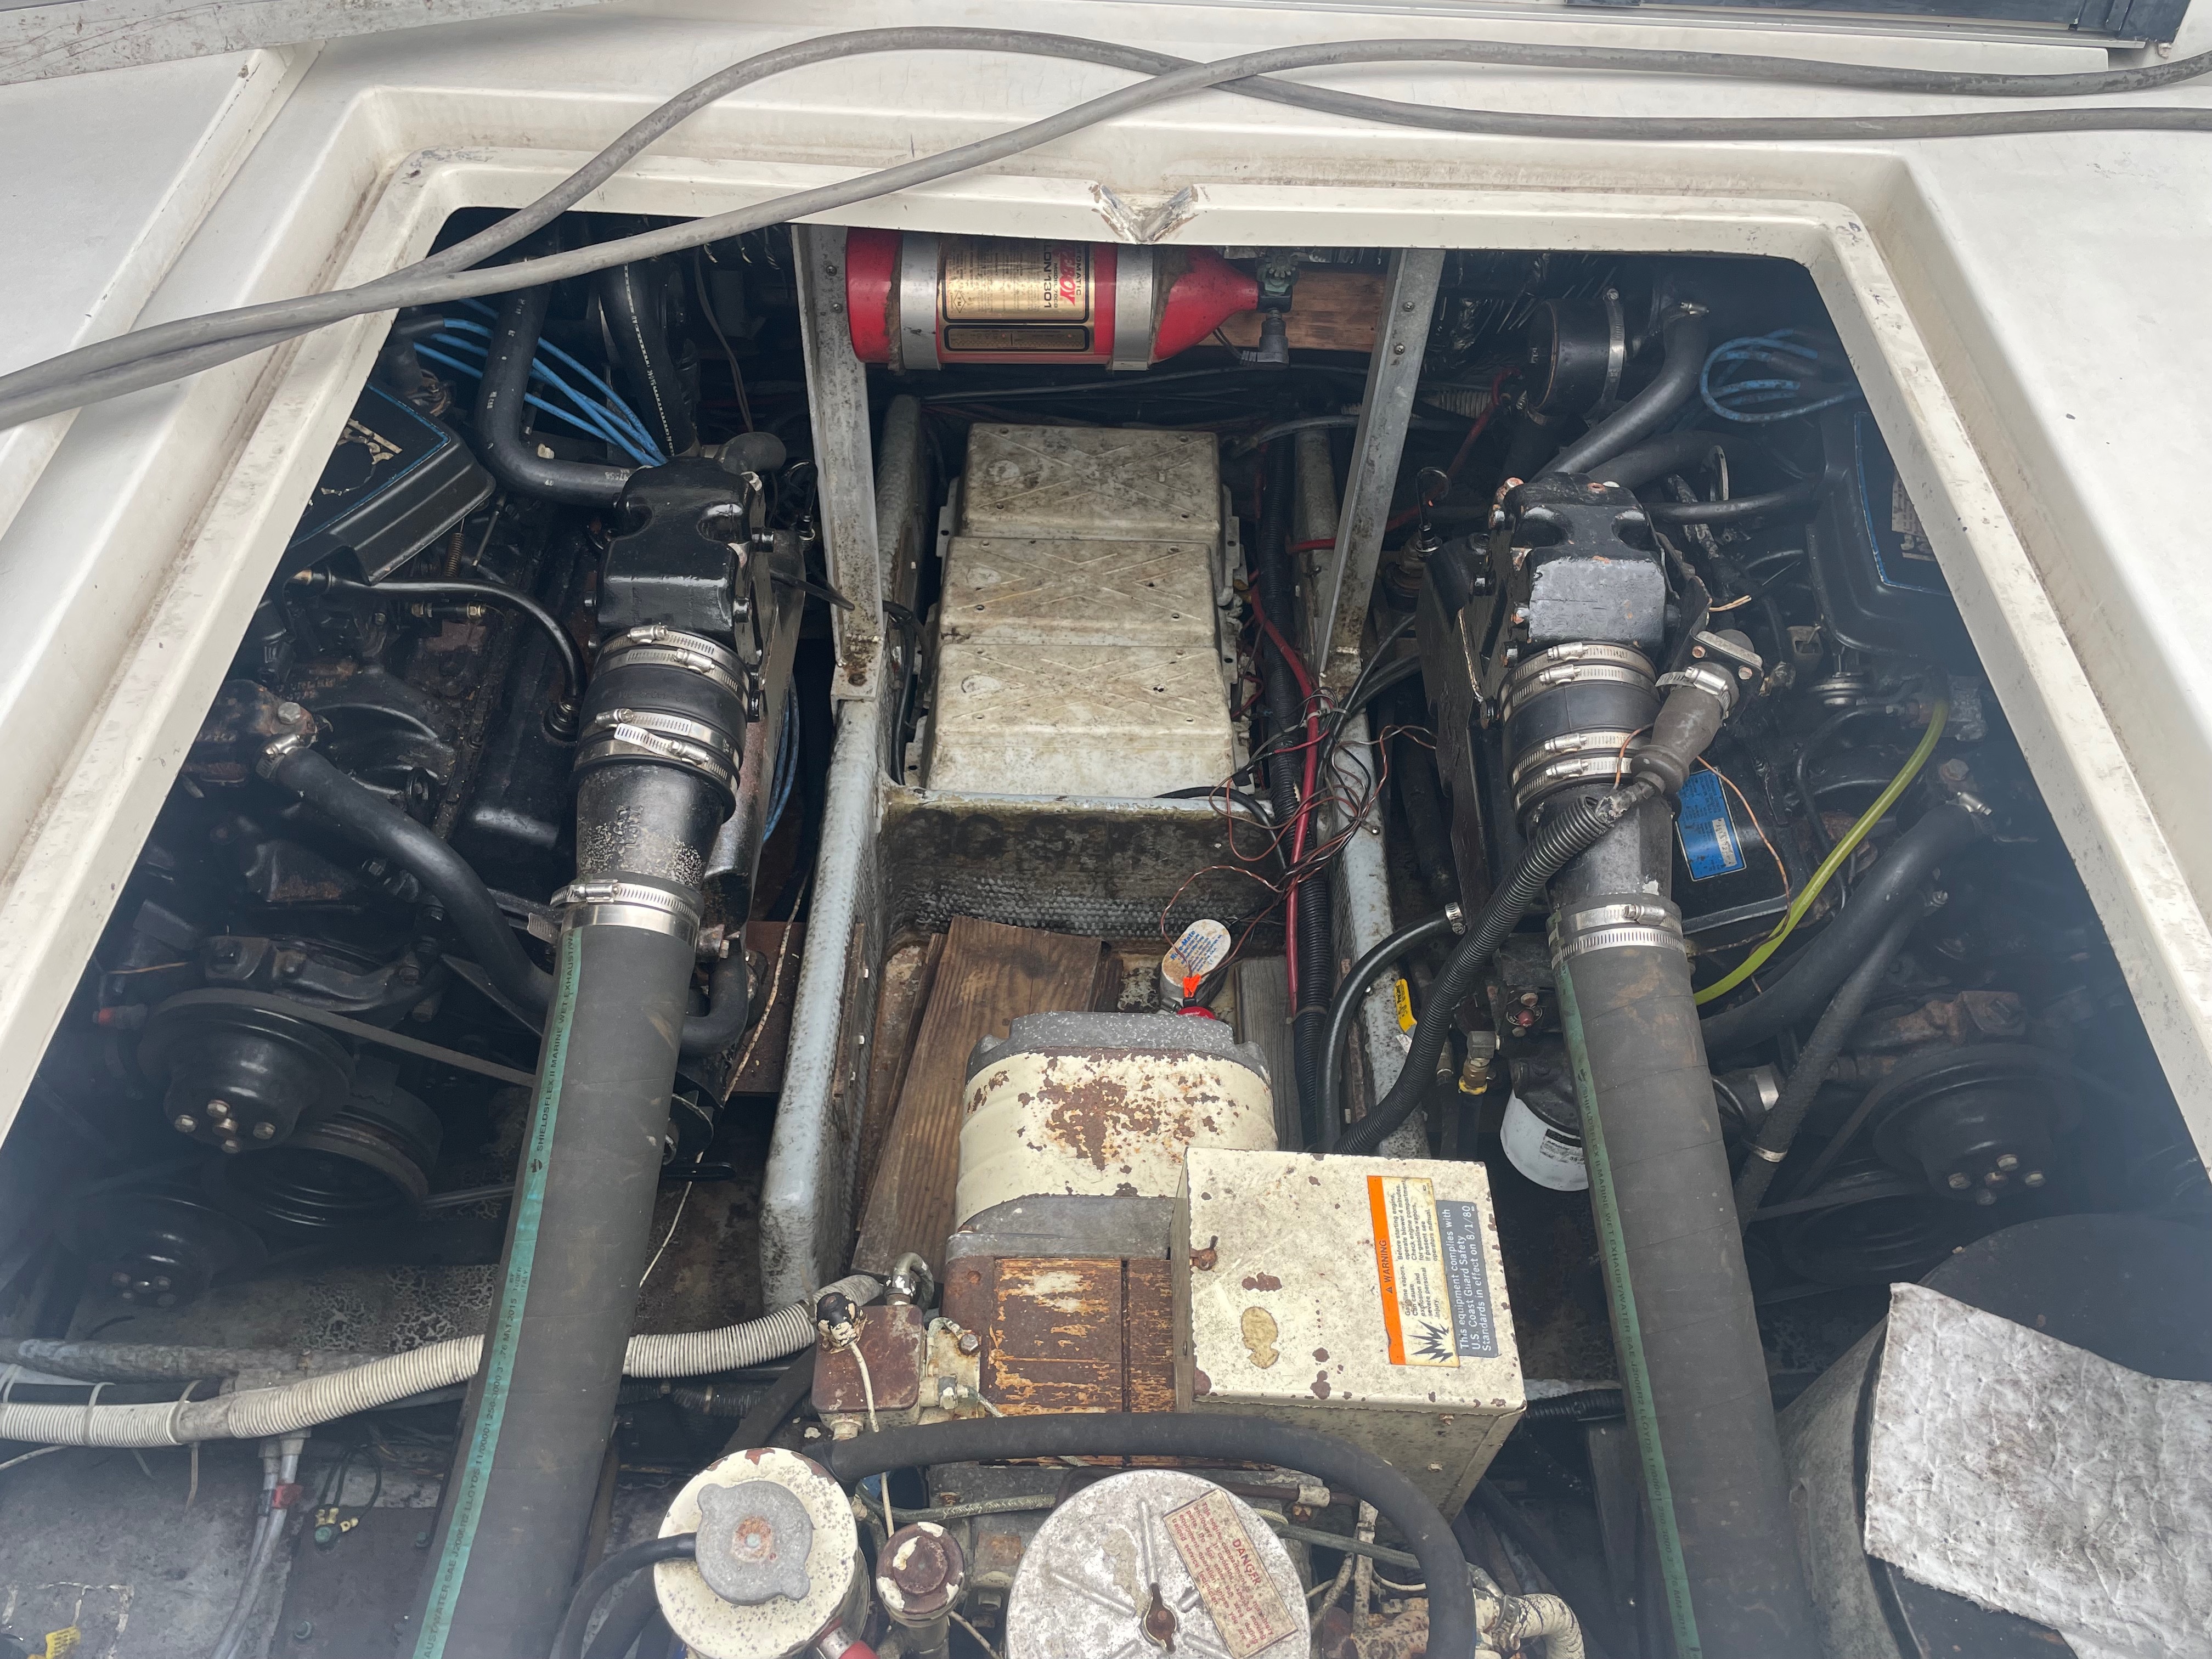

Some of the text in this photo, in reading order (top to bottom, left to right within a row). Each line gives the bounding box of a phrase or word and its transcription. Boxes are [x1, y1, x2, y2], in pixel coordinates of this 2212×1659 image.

[1043, 275, 1052, 308] 1301
[1170, 929, 1197, 960] Rue-Mate
[535, 1079, 555, 1152] SHIELDSFLEX
[550, 1026, 563, 1068] MARINE
[558, 1000, 568, 1024] WET
[1581, 1088, 1600, 1157] SHIELDSFLEX
[1596, 1169, 1609, 1209] MARINE
[1392, 1216, 1401, 1239] starting
[1414, 1225, 1423, 1250] gasoline
[1422, 1233, 1430, 1255] present
[1429, 1233, 1437, 1261] operators
[1604, 1212, 1615, 1237] WET
[1379, 1239, 1391, 1283] WARNING
[1420, 1267, 1430, 1294] personal
[1442, 1209, 1469, 1349] This equipment complies with
[1462, 1204, 1489, 1351] Standards in effect on 8/1/80
[1399, 1264, 1410, 1316] Gasoline vapors.
[1416, 1284, 1426, 1316] explosion
[1455, 1234, 1481, 1350] U.S. Coast Guard Safety
[1608, 1239, 1631, 1332] EXHAUST/WATER
[1626, 1335, 1635, 1356] SAE
[1639, 1408, 1652, 1453] LLOYDS
[422, 1583, 451, 1658] AUST/WATER
[465, 1468, 481, 1511] LLOYDS
[506, 1298, 517, 1321] 2015
[1171, 1518, 1186, 1541] trained
[1184, 1544, 1200, 1568] service
[1201, 1502, 1211, 1516] This
[1208, 1517, 1223, 1540] engine
[1220, 1541, 1247, 1584] compartment
[1231, 1538, 1262, 1586] DANGER
[1178, 1514, 1200, 1549] equipment
[1197, 1551, 1217, 1583] operation
[1215, 1586, 1229, 1609] unless
[1228, 1612, 1238, 1624] you
[1238, 1628, 1246, 1640] are
[1198, 1533, 1205, 1543] Do
[1205, 1546, 1214, 1559] Not
[1214, 1563, 1225, 1581] enter
[1224, 1585, 1234, 1598] this
[1233, 1602, 1243, 1617] area
[1243, 1621, 1259, 1644] during
[1233, 1583, 1251, 1612] exposed
[1250, 1615, 1266, 1640] moving
